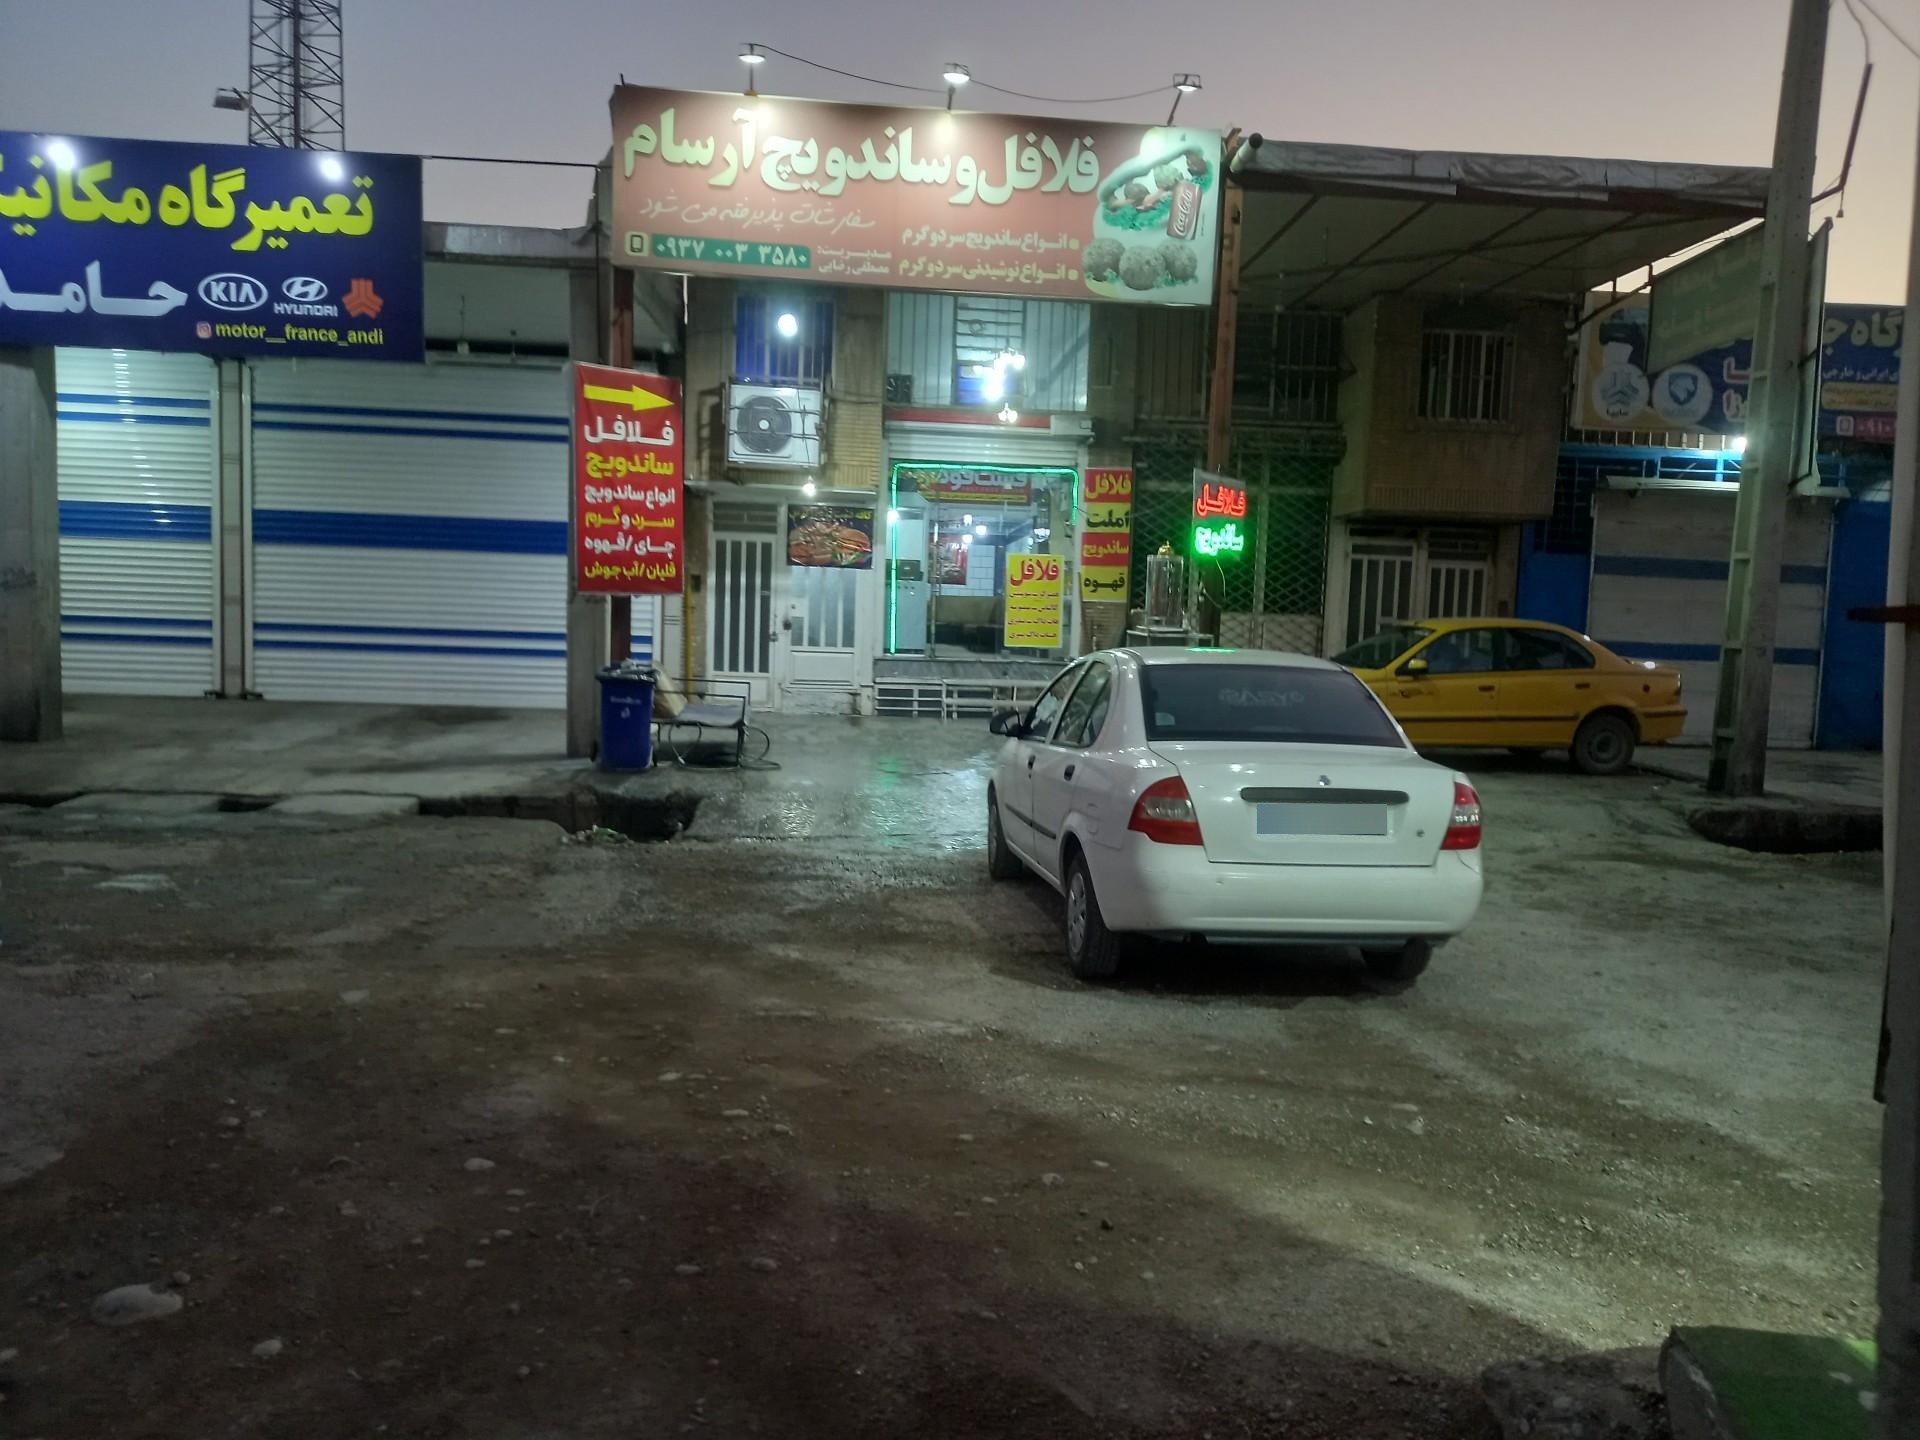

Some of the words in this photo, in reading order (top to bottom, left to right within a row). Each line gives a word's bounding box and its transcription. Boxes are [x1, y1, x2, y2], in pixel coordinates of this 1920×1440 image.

[623, 106, 758, 188] آرسام
[760, 125, 951, 197] ساندویچ
[976, 130, 1100, 205] فلافل
[948, 155, 978, 205] و
[0, 154, 151, 237] مکانی
[159, 163, 374, 252] تعمیرگاه
[656, 236, 705, 259] ۰۹۳۷
[714, 242, 749, 263] ۰۰۳
[757, 245, 808, 267] ۳۵۸۰
[965, 228, 1021, 250] ساندویچ
[1020, 231, 1068, 253] انواع
[1018, 261, 1067, 284] انواع
[210, 281, 257, 304] KIA
[273, 302, 338, 317] HYUNDAI
[584, 414, 675, 446] فلافل
[585, 451, 674, 478] ساندویچ
[584, 484, 645, 504] ساندویچ
[645, 486, 676, 509] انواع
[1085, 472, 1132, 499] فلافل
[1196, 482, 1247, 517] فلافل
[585, 504, 622, 528] گرم
[631, 512, 675, 529] سرد
[1082, 539, 1129, 559] ساندویچ
[1194, 523, 1244, 556] ساندویچ
[1010, 558, 1060, 587] فلافل
[1084, 572, 1126, 594] قهوه
